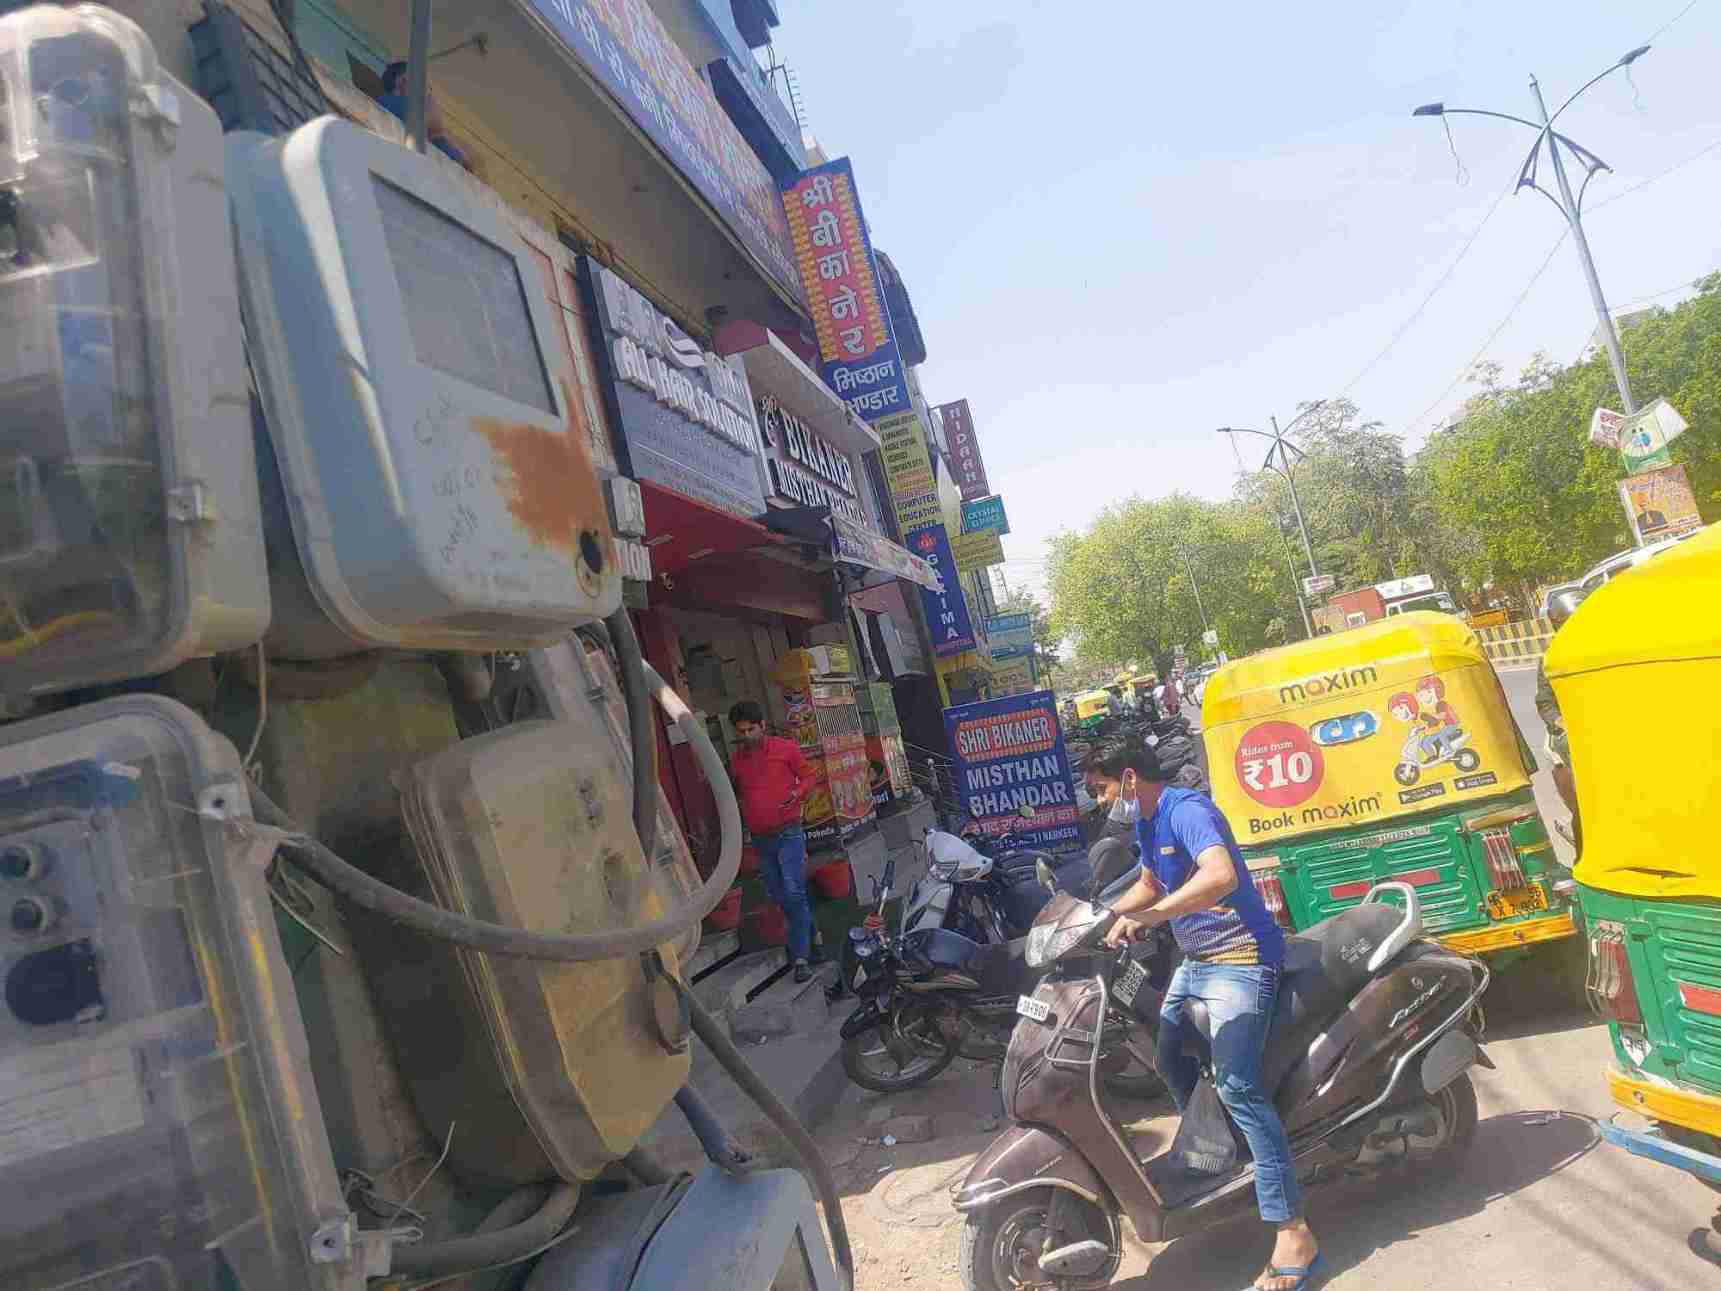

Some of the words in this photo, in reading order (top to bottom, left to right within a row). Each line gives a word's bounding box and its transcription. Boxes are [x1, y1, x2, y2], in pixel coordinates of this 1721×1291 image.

[802, 175, 833, 208] श्री
[1280, 664, 1377, 704] maxim
[959, 726, 991, 754] SHRI
[991, 717, 1051, 749] BIKANER
[966, 754, 1060, 790] MISTHAN
[1243, 751, 1313, 792] ₹10
[968, 781, 1070, 817] BHANDAR
[1250, 811, 1295, 834] Book
[1302, 795, 1380, 825] maxim
